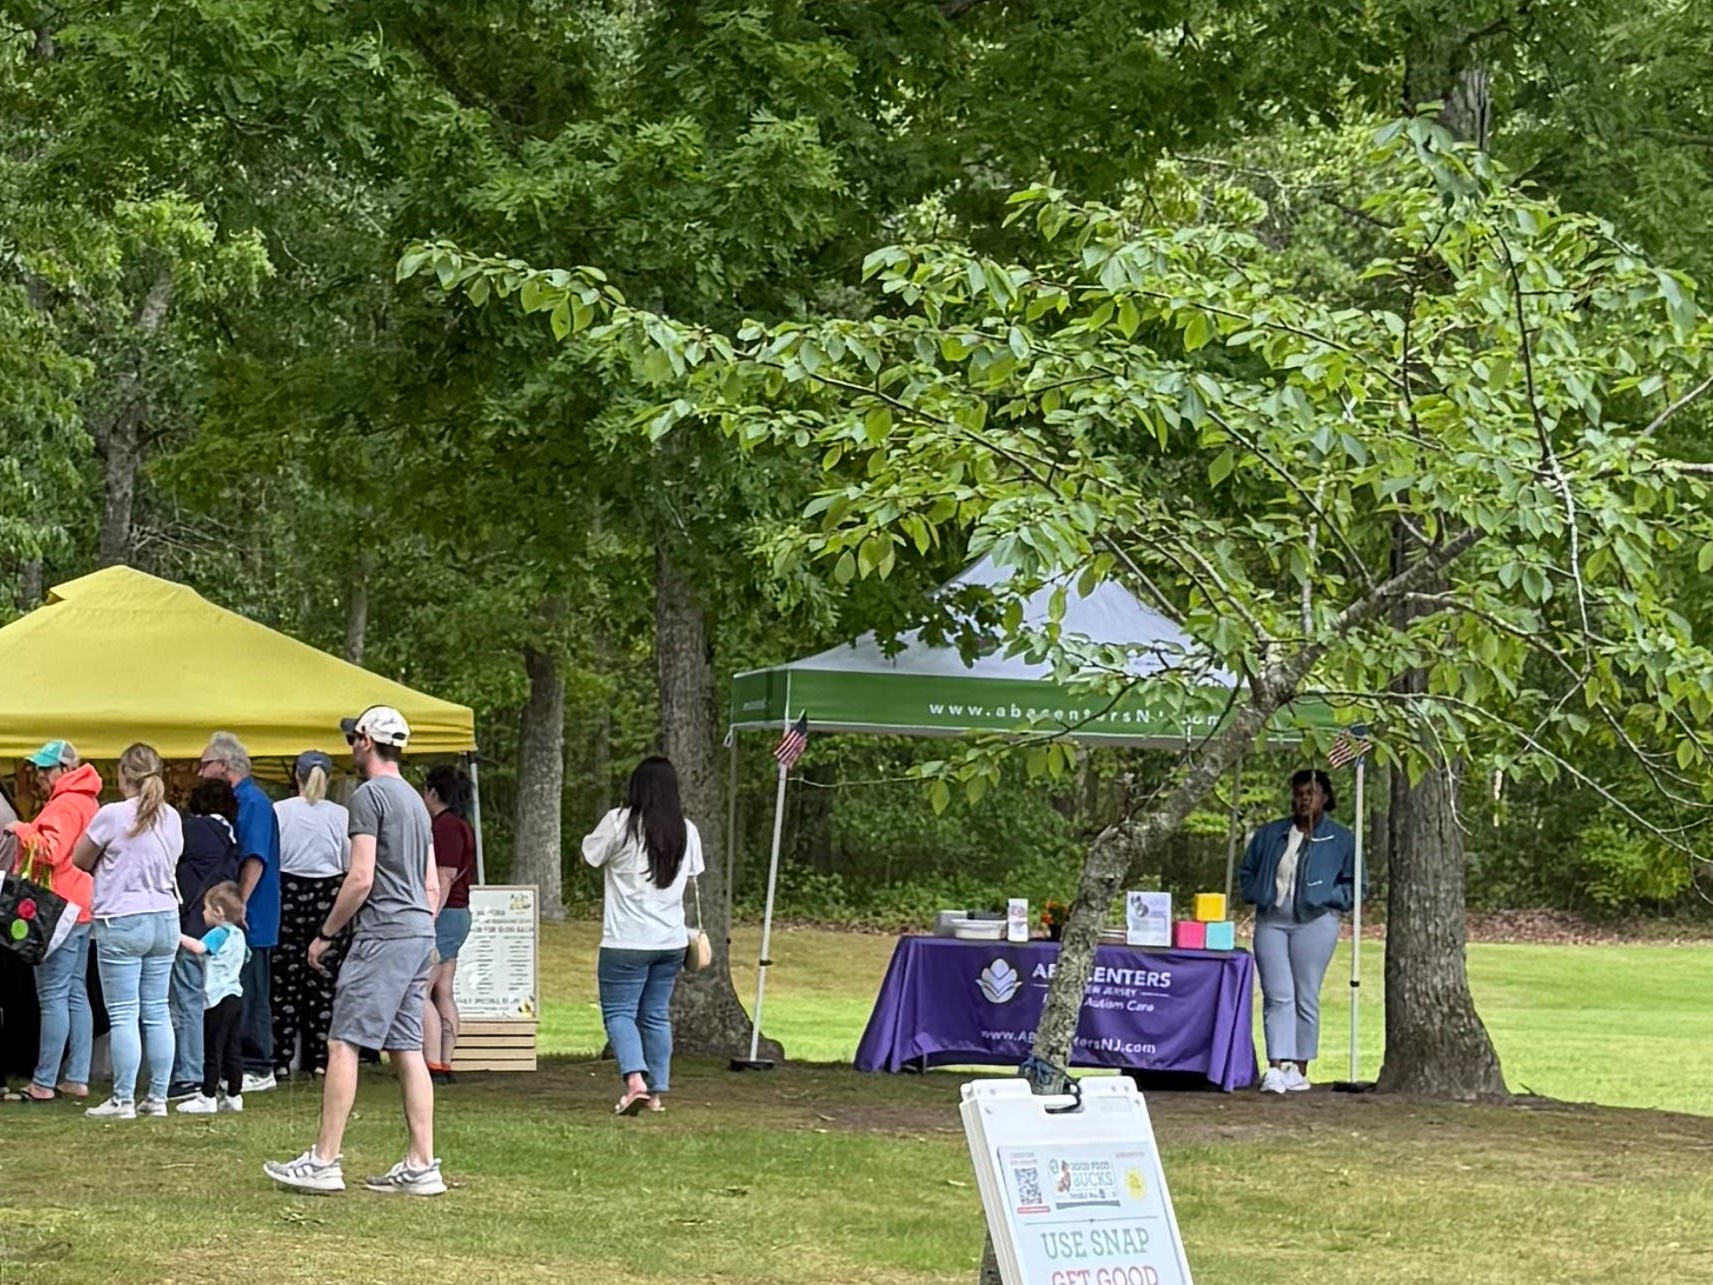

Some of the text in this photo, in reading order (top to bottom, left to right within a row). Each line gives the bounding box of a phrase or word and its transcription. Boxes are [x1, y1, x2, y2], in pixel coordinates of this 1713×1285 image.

[1087, 966, 1172, 988] ENTERS
[1084, 997, 1155, 1013] Autism Care
[1071, 1171, 1114, 1187] BUCKS
[1041, 1227, 1150, 1260] USE SNAP
